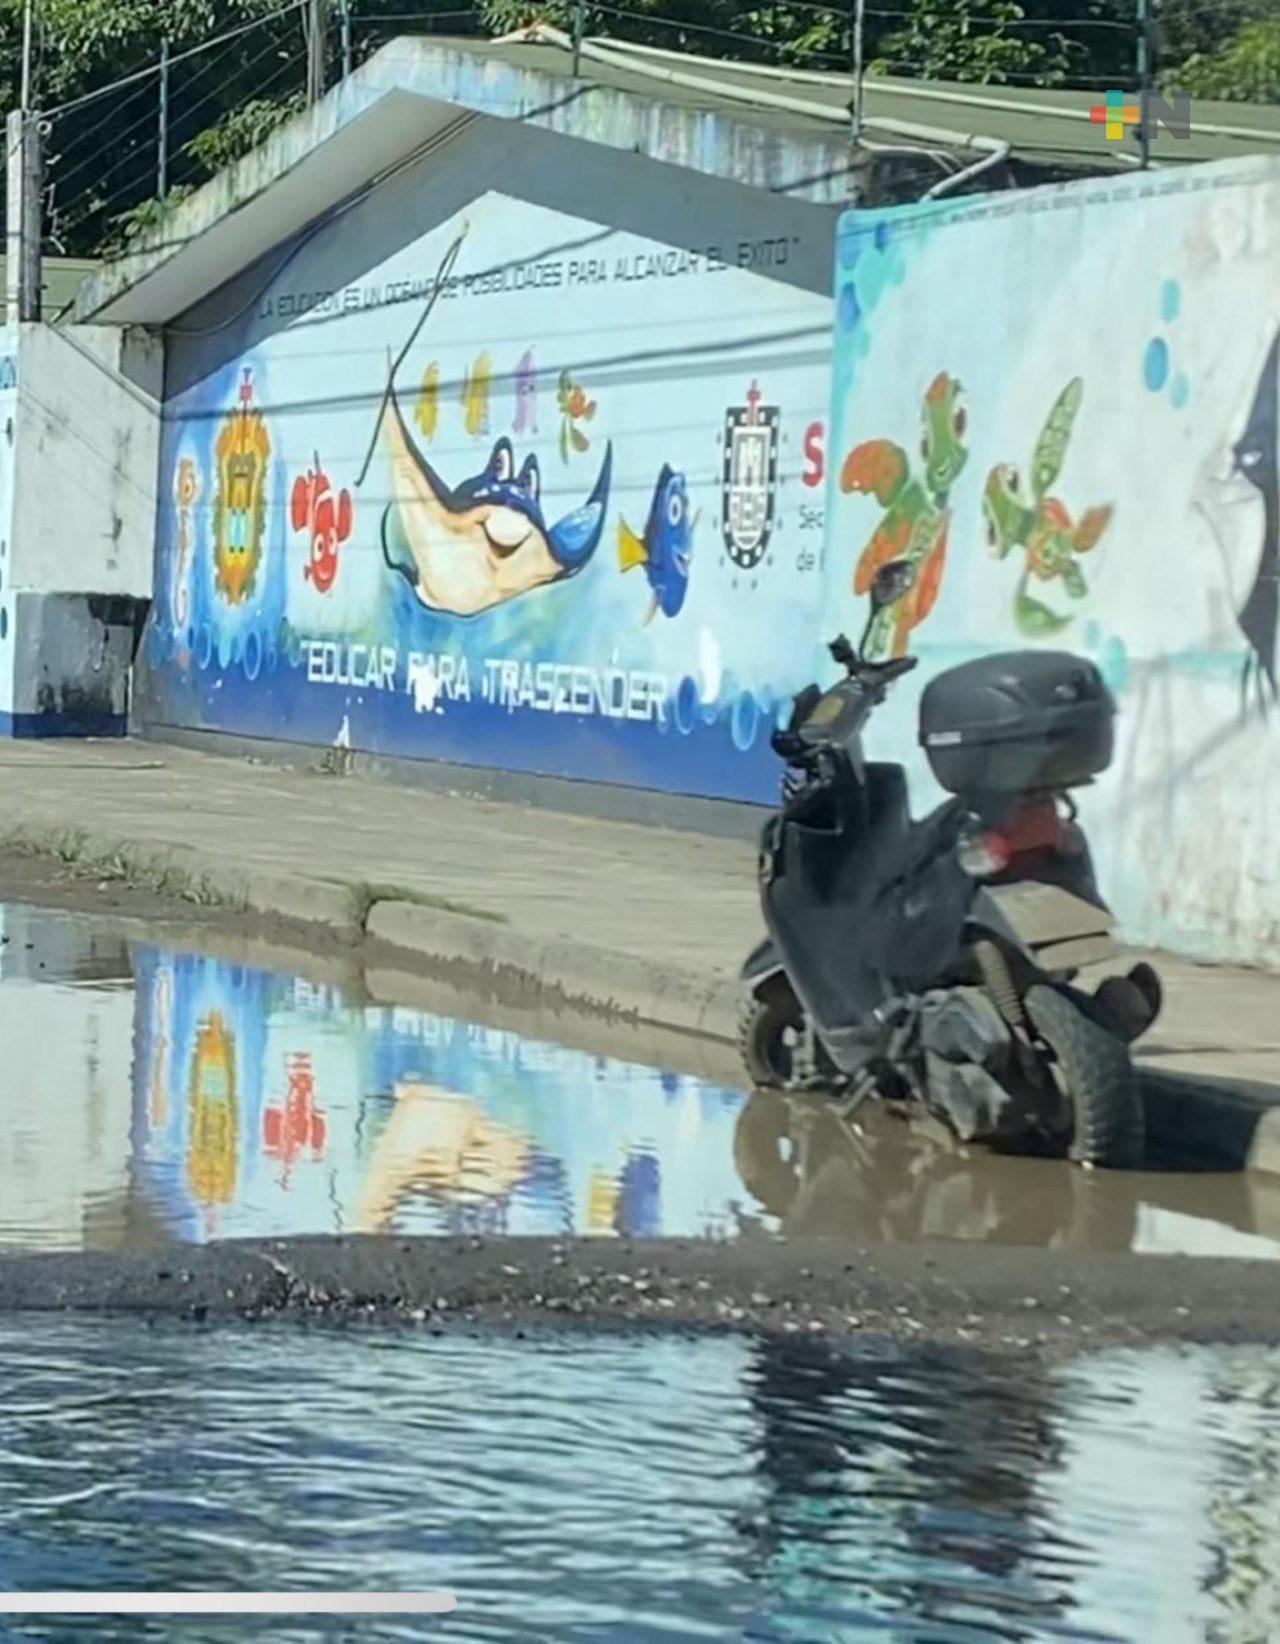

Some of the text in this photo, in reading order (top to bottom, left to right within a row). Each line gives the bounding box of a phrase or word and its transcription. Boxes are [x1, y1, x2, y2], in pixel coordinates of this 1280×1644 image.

[568, 259, 607, 285] PARA
[613, 248, 700, 282] ALCANZAR
[706, 246, 728, 273] EL
